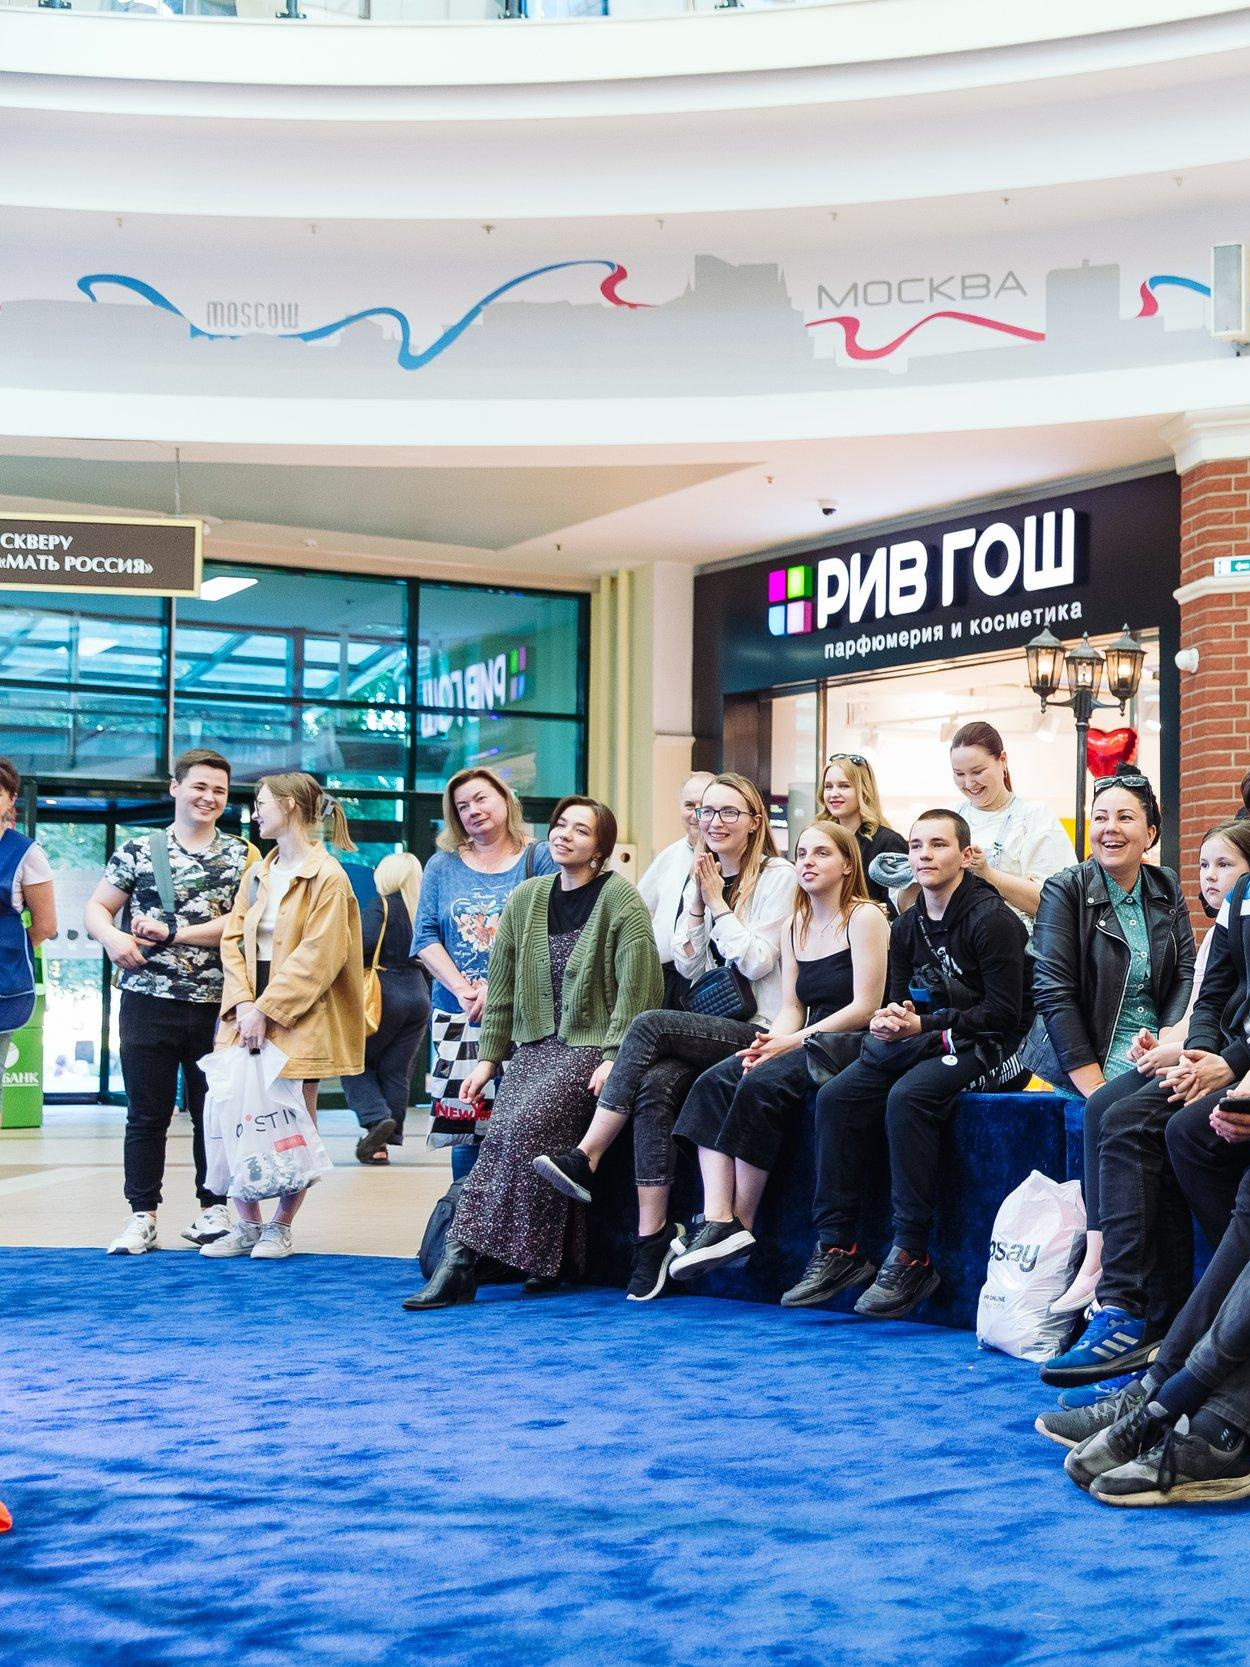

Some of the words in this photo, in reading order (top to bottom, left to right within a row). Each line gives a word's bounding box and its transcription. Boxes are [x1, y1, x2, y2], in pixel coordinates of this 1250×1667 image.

[818, 270, 1028, 309] МОСКВА
[206, 300, 298, 328] MOSCOW
[0, 532, 73, 551] СКВЕРУ
[64, 555, 154, 574] РОССИЯ»
[816, 540, 928, 629] РИВ
[942, 507, 1075, 607] ГОШ
[823, 624, 943, 660] парфюмерия
[951, 621, 962, 639] и
[969, 601, 1083, 636] косметика
